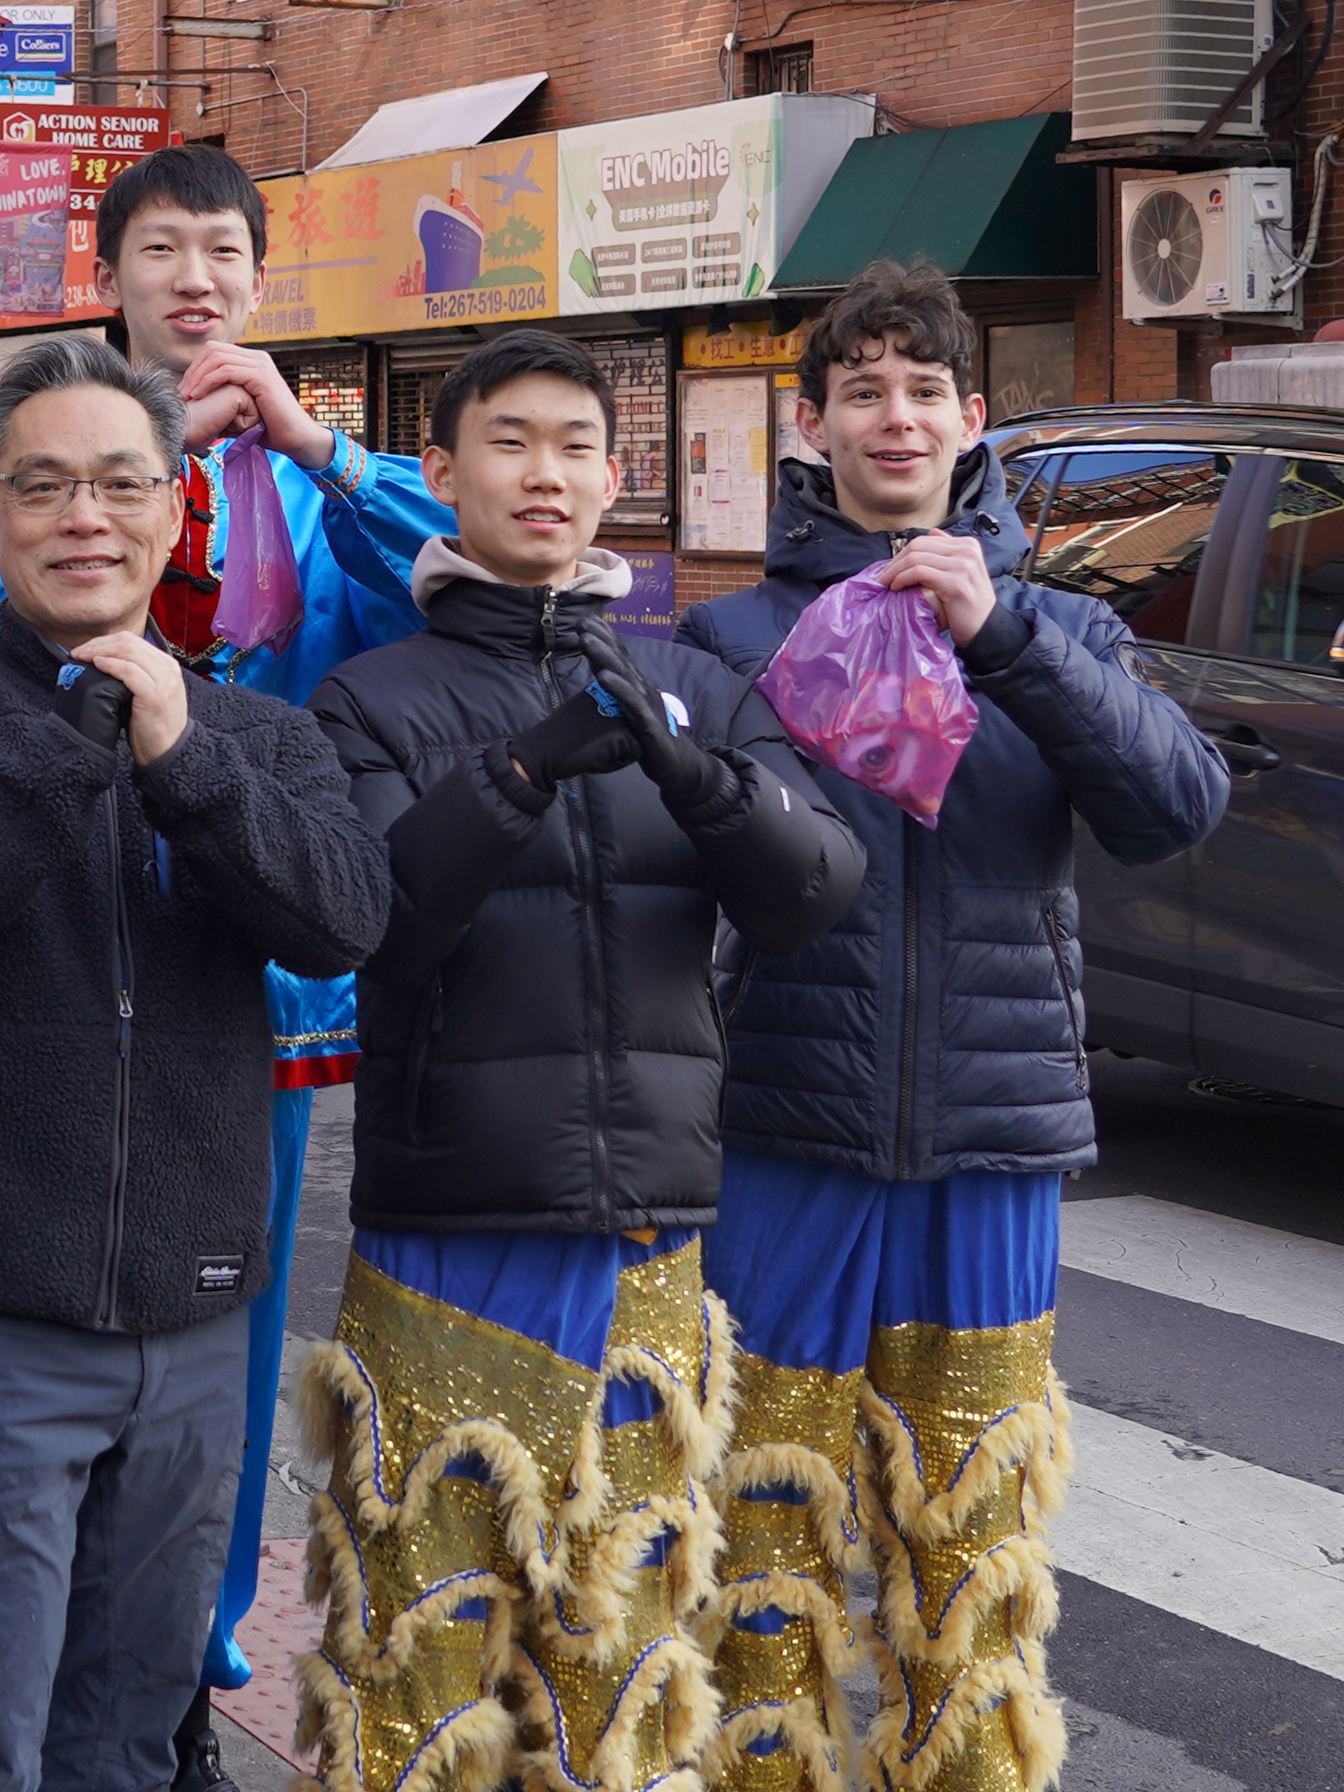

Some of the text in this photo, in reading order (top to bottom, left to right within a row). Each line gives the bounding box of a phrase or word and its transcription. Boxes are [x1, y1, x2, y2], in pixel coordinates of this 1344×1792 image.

[22, 9, 56, 21] ONLY
[38, 113, 159, 133] ACTION SENIOR
[52, 131, 144, 149] HOME CARE
[601, 138, 730, 192] ENC Mobile
[262, 277, 305, 306] RAVEL
